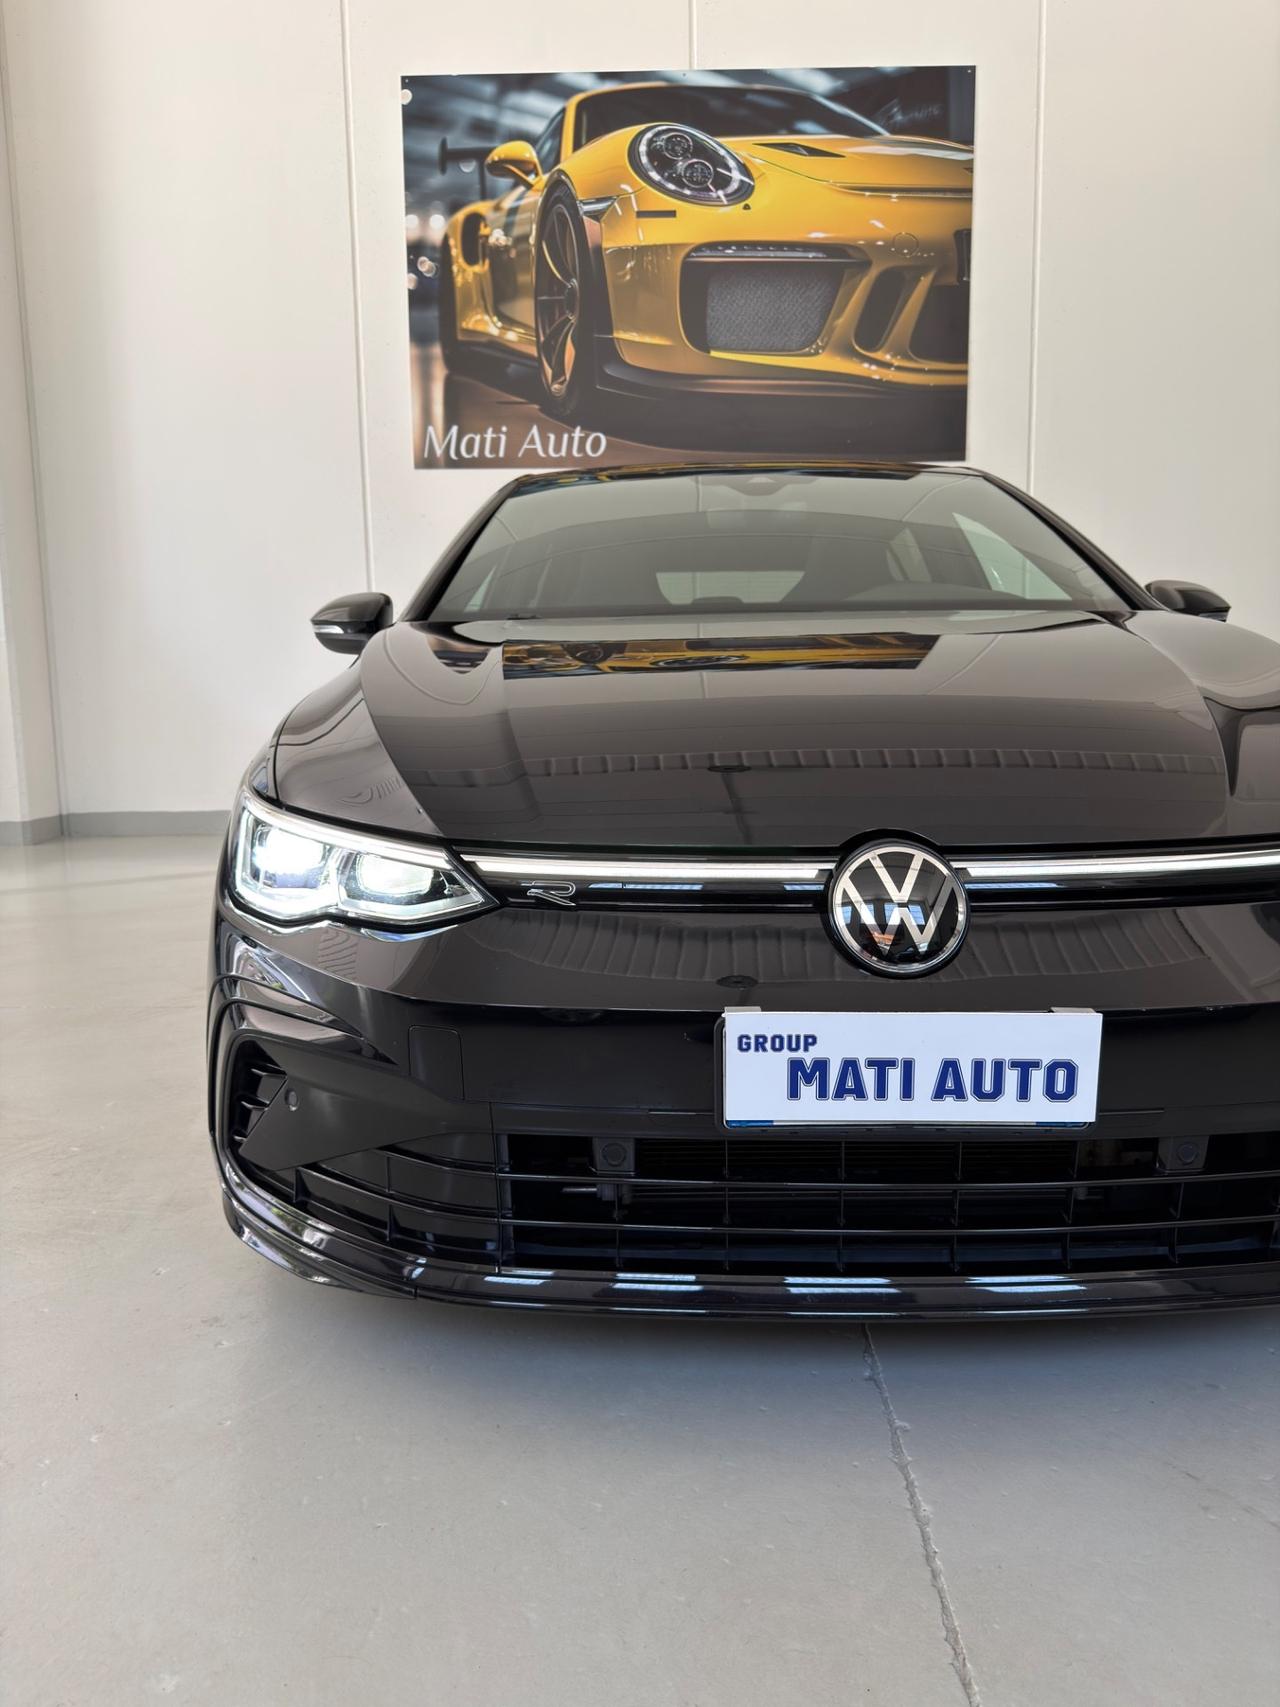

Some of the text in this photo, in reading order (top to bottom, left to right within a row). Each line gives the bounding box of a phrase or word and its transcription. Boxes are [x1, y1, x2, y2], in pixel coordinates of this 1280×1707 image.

[423, 424, 607, 461] Mati Auto
[836, 847, 963, 967] VW
[736, 1033, 818, 1053] GROUP
[786, 1057, 1079, 1103] MATI AUTO
